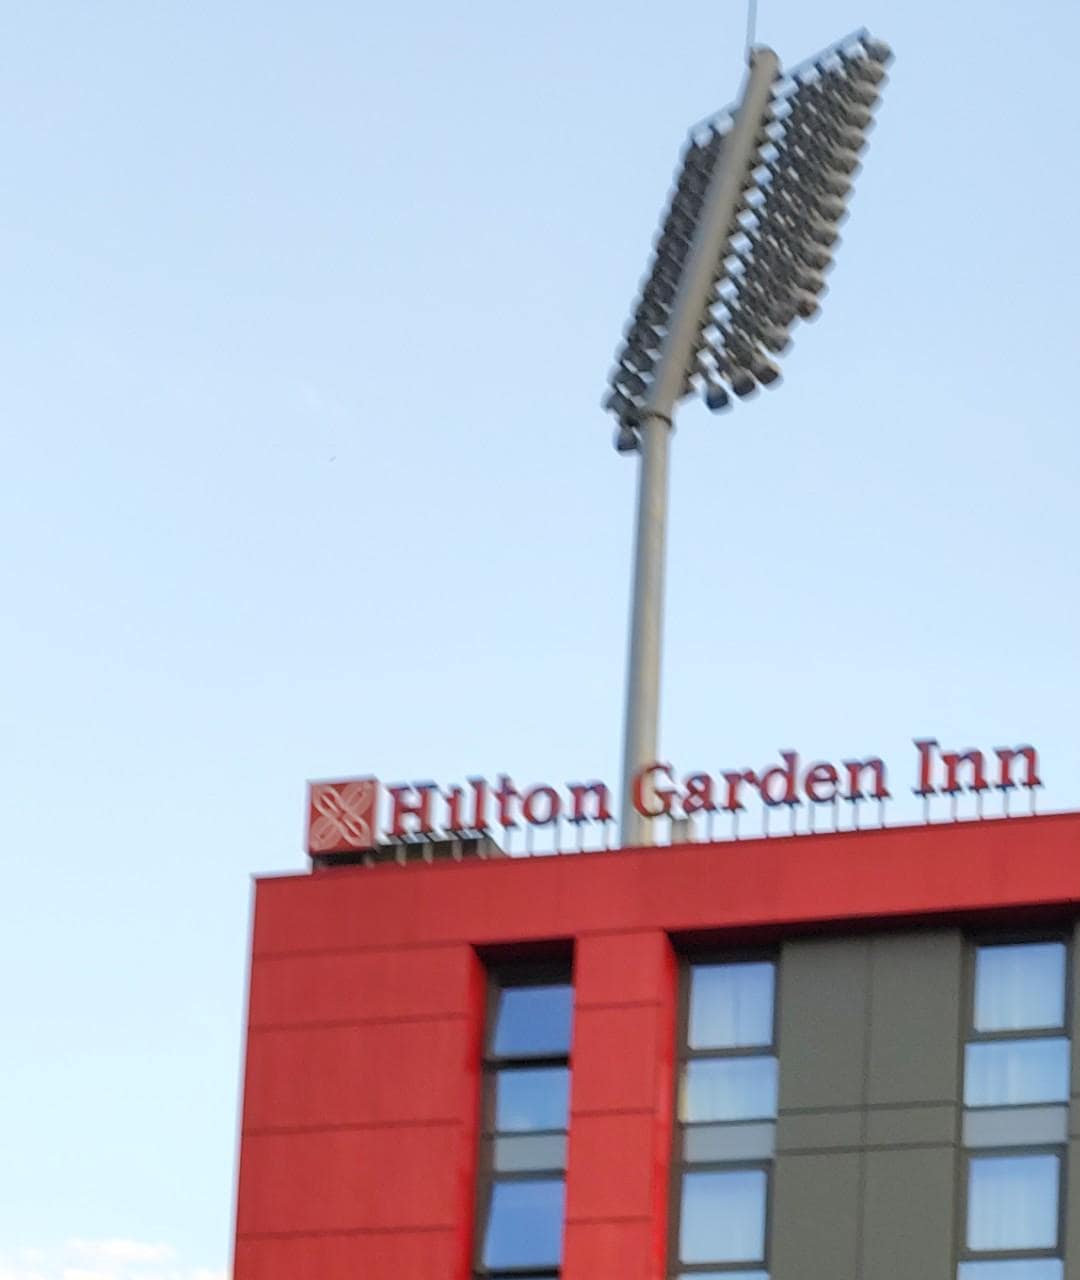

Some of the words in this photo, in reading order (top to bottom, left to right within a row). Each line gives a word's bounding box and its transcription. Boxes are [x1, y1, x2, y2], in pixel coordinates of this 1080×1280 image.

[385, 773, 612, 837] Hilton
[632, 749, 888, 819] Garden
[914, 739, 1042, 798] Inn
